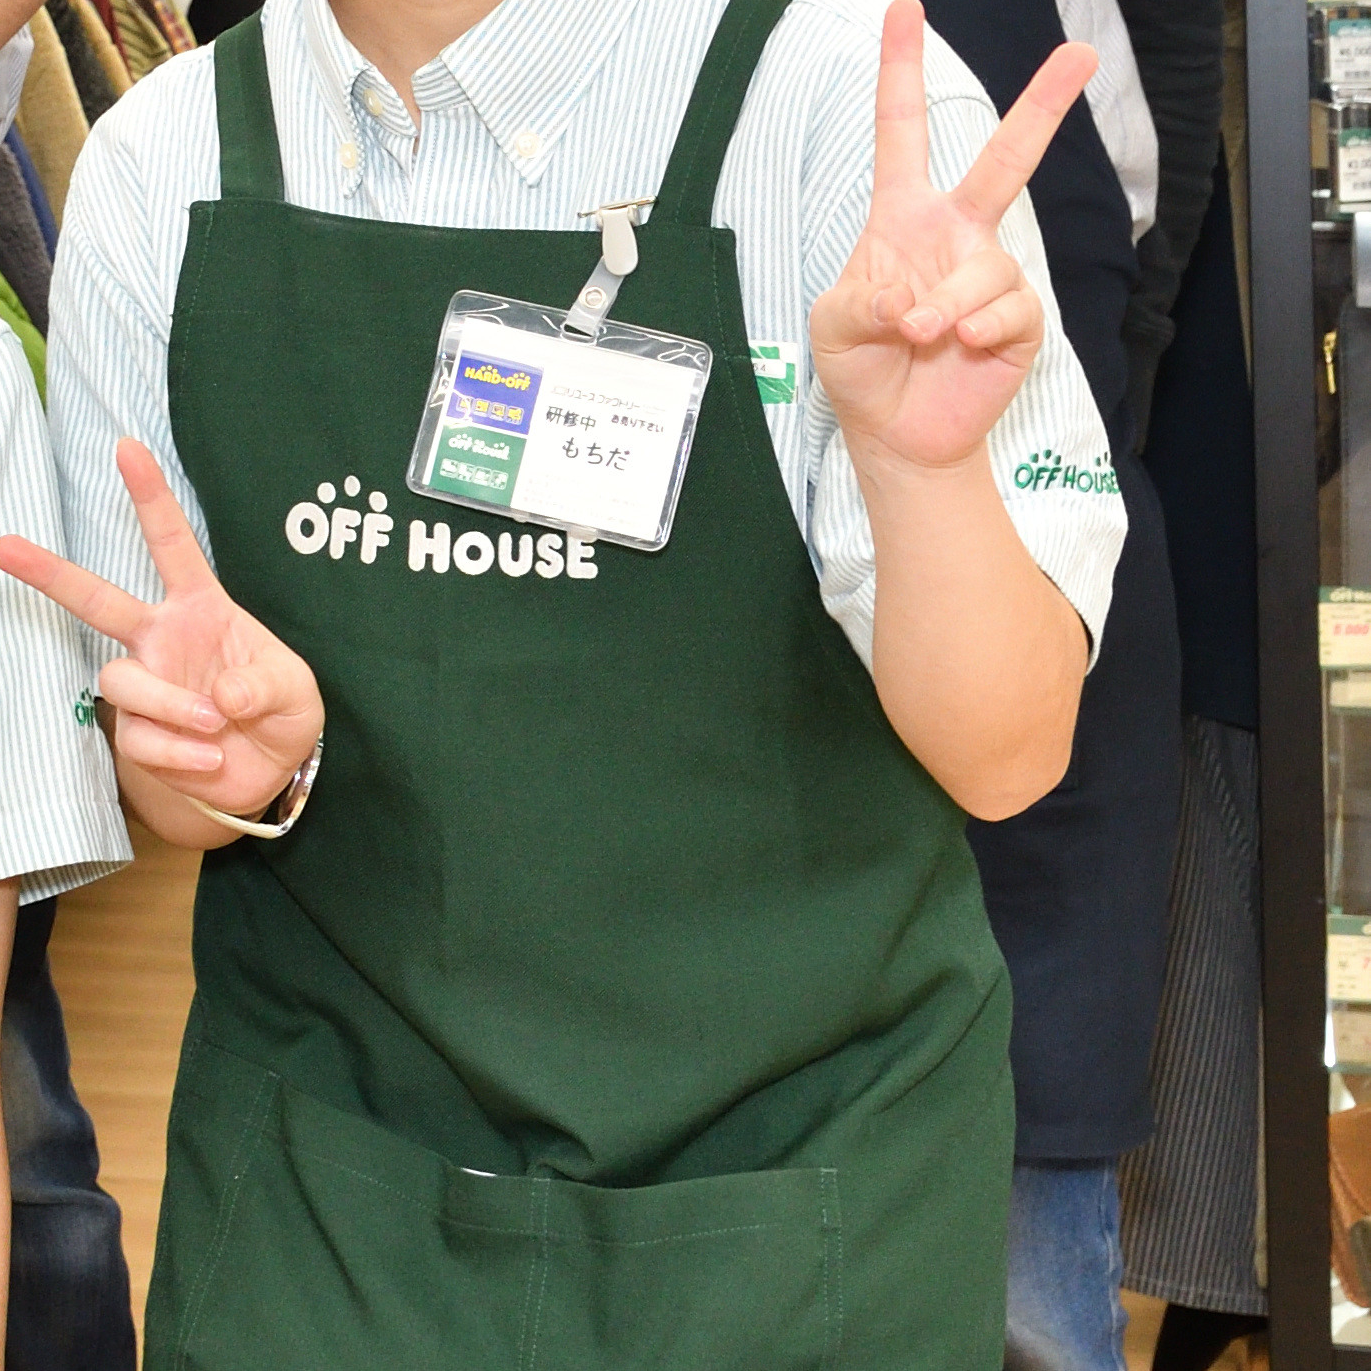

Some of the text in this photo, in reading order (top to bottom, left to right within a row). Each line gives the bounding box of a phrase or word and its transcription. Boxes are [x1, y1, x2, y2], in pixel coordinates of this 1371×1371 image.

[545, 405, 597, 432] 研修中
[562, 437, 632, 472] もちだ
[1014, 461, 1062, 492] OFF
[285, 498, 599, 580] OFF HOUSE
